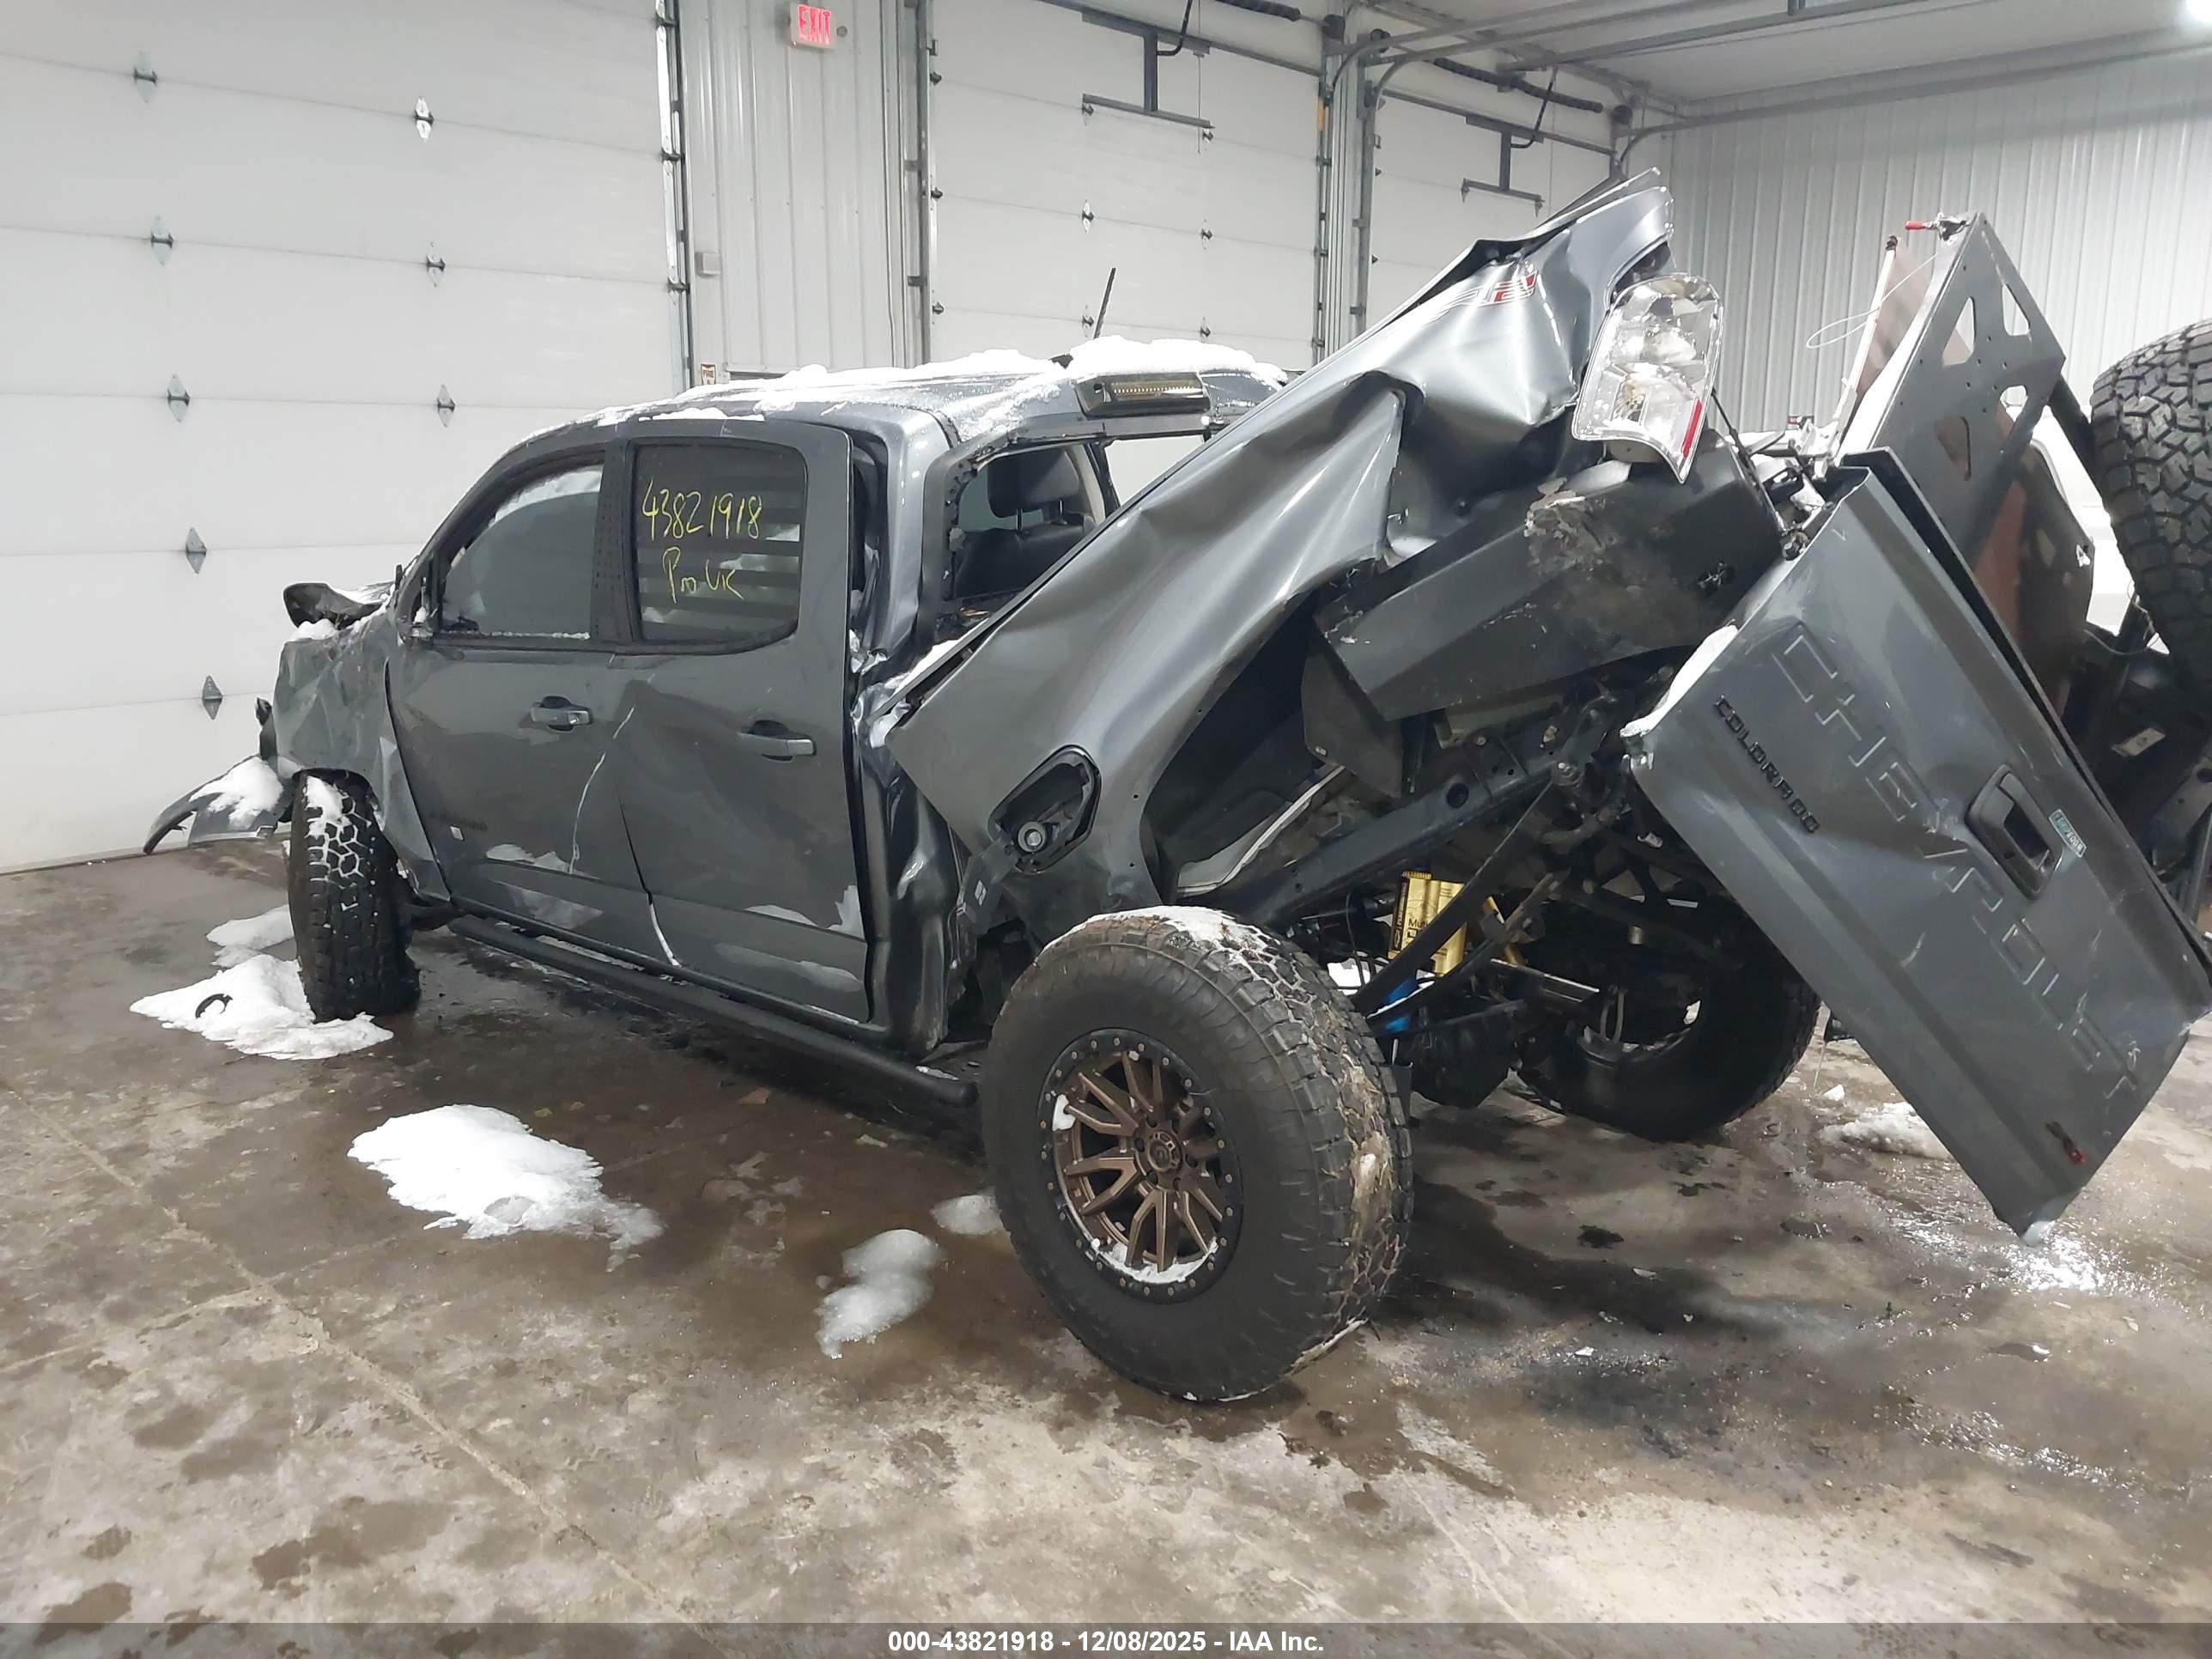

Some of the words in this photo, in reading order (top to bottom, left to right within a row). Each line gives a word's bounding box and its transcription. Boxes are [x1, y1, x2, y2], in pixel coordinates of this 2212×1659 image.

[798, 4, 831, 46] EXIT
[642, 478, 763, 542] 43821918
[1713, 694, 1820, 834] COLORADO
[1771, 623, 2137, 1097] CHEVROLET
